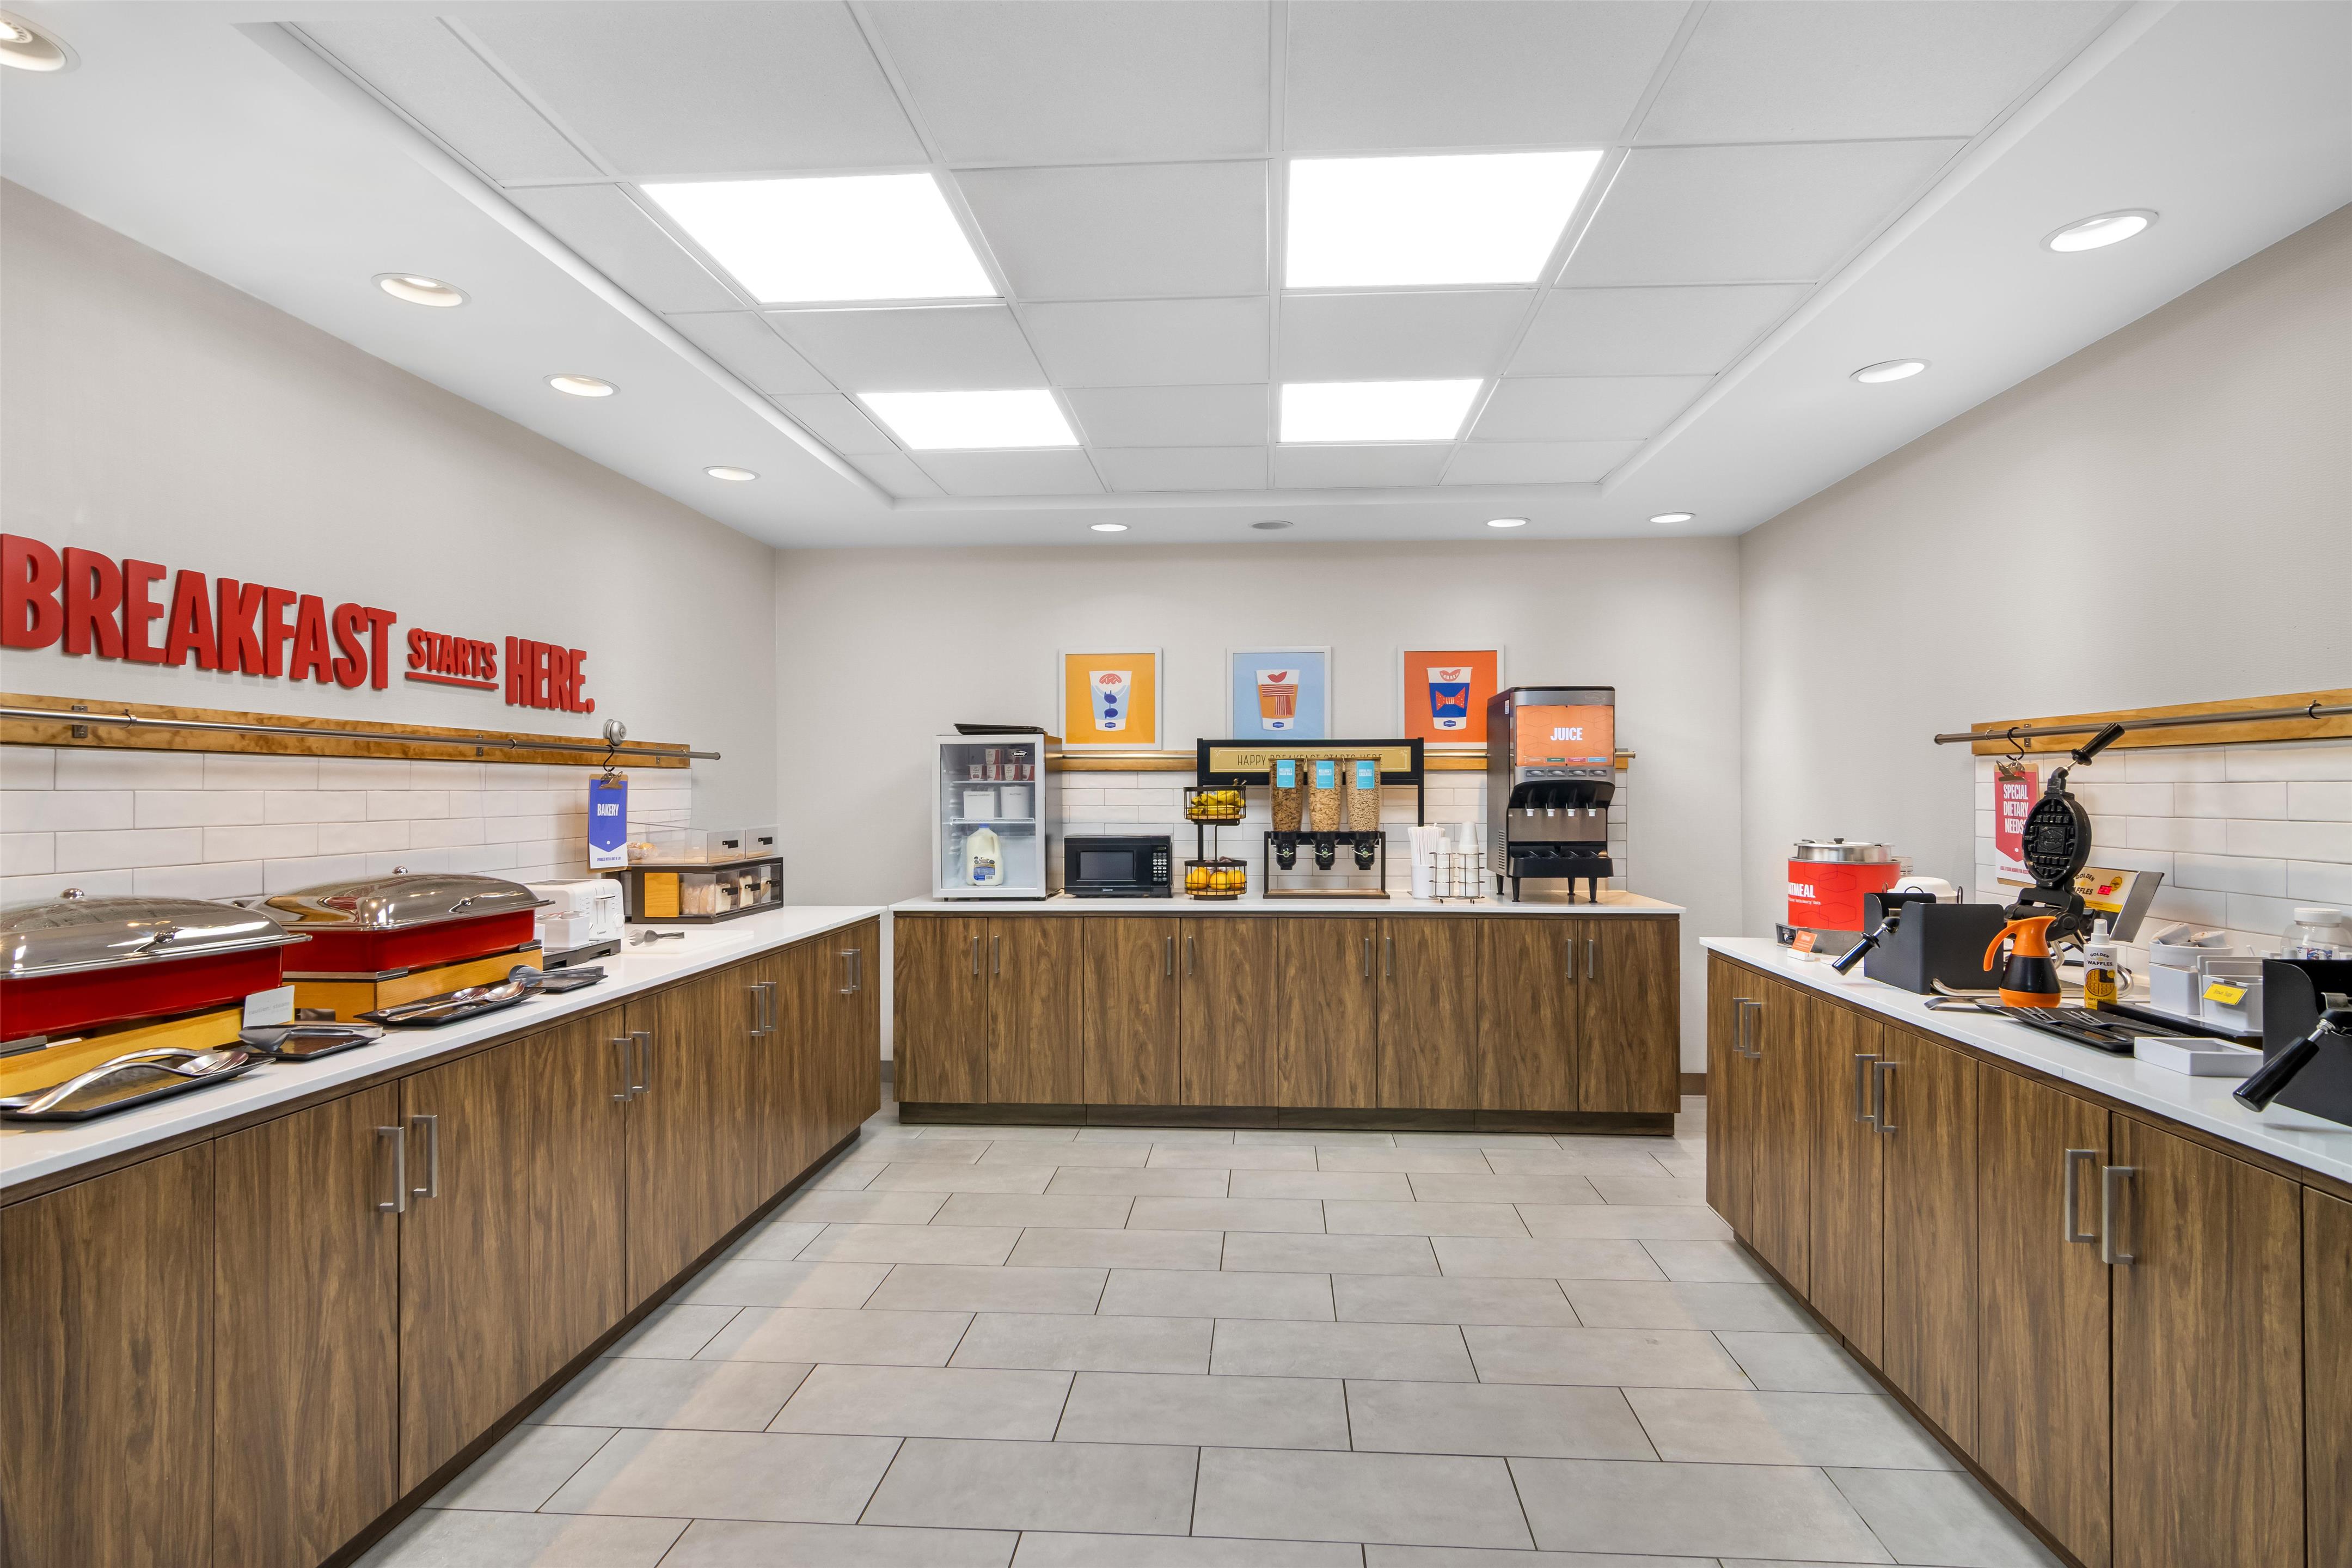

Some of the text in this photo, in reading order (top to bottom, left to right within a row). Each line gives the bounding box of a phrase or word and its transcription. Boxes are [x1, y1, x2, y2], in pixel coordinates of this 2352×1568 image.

[0, 533, 595, 713] BREAKFAST STARTS HERE.
[1550, 727, 1583, 740] JUICE
[1238, 755, 1266, 765] HAPPY
[2003, 783, 2029, 800] SPECIAL
[597, 804, 619, 816] BAKERY
[2003, 801, 2029, 817] DIETARY
[2075, 873, 2095, 882] GOLDEN
[2074, 887, 2093, 895] FFLES
